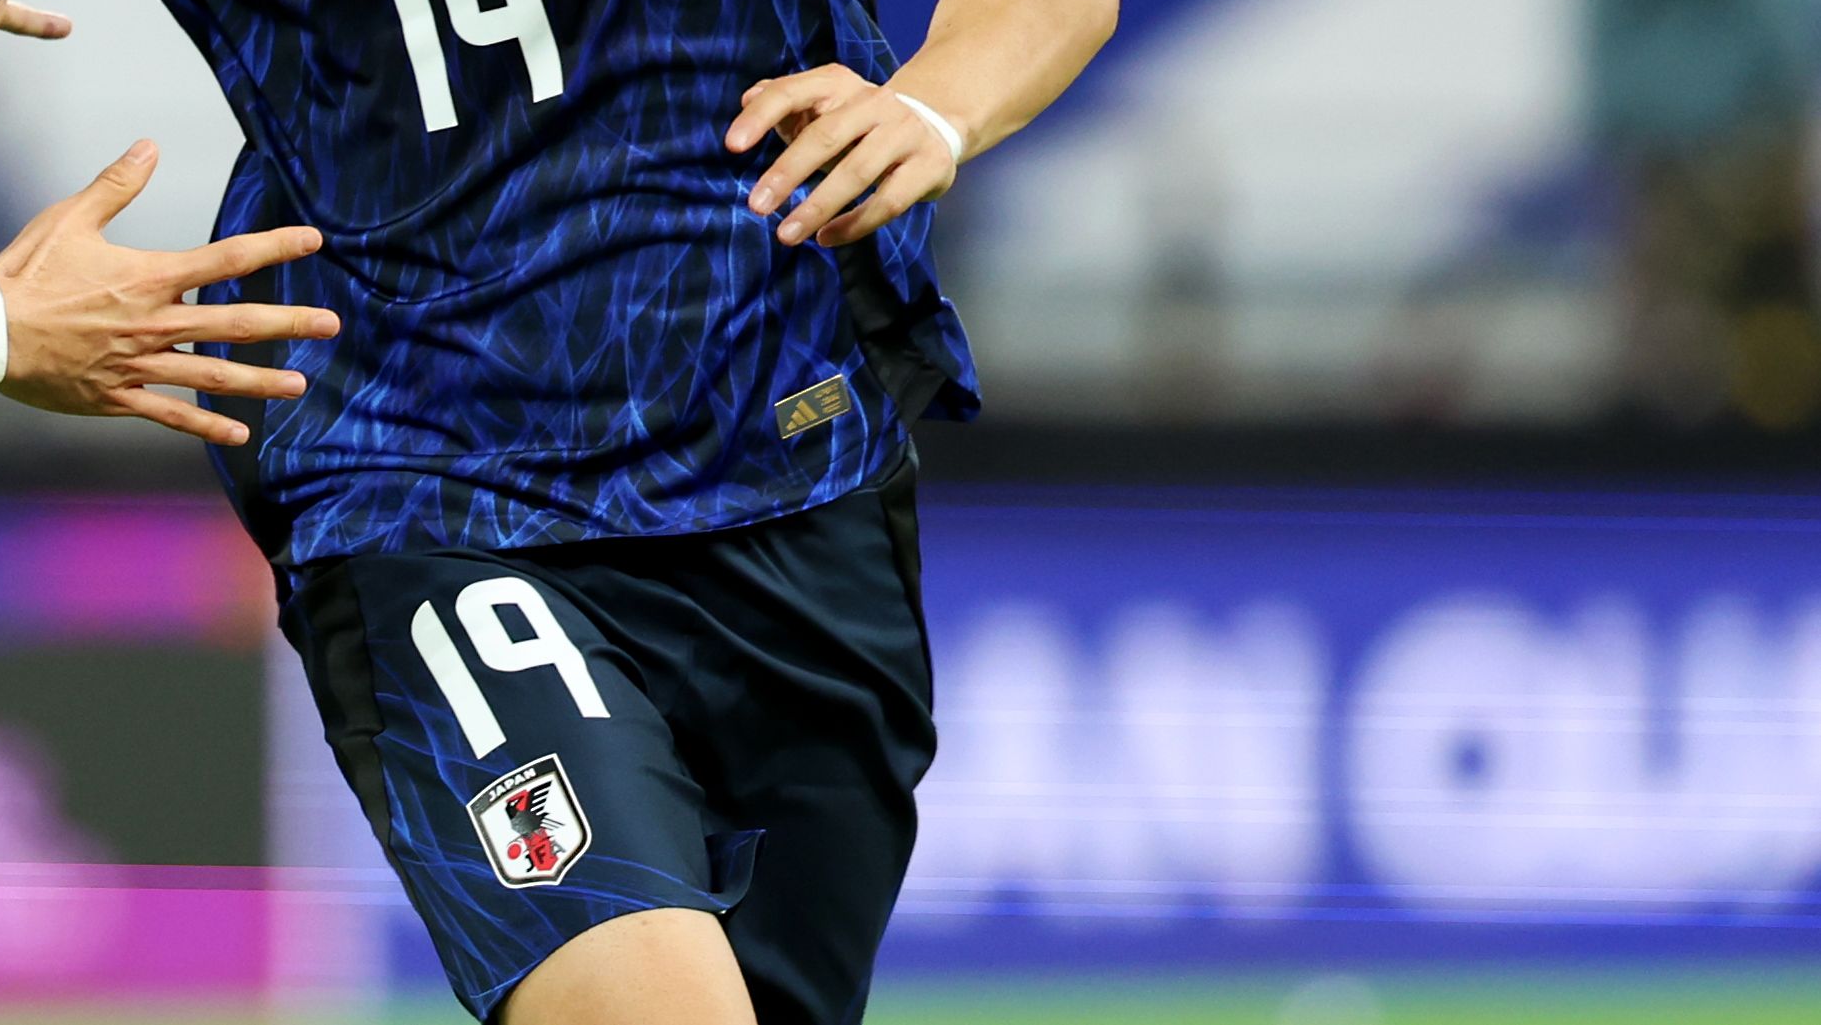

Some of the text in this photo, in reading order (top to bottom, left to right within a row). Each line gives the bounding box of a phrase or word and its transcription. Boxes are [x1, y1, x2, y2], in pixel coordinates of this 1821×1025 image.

[410, 576, 611, 759] 19
[488, 767, 537, 803] JAPAN
[523, 840, 567, 873] JFA
